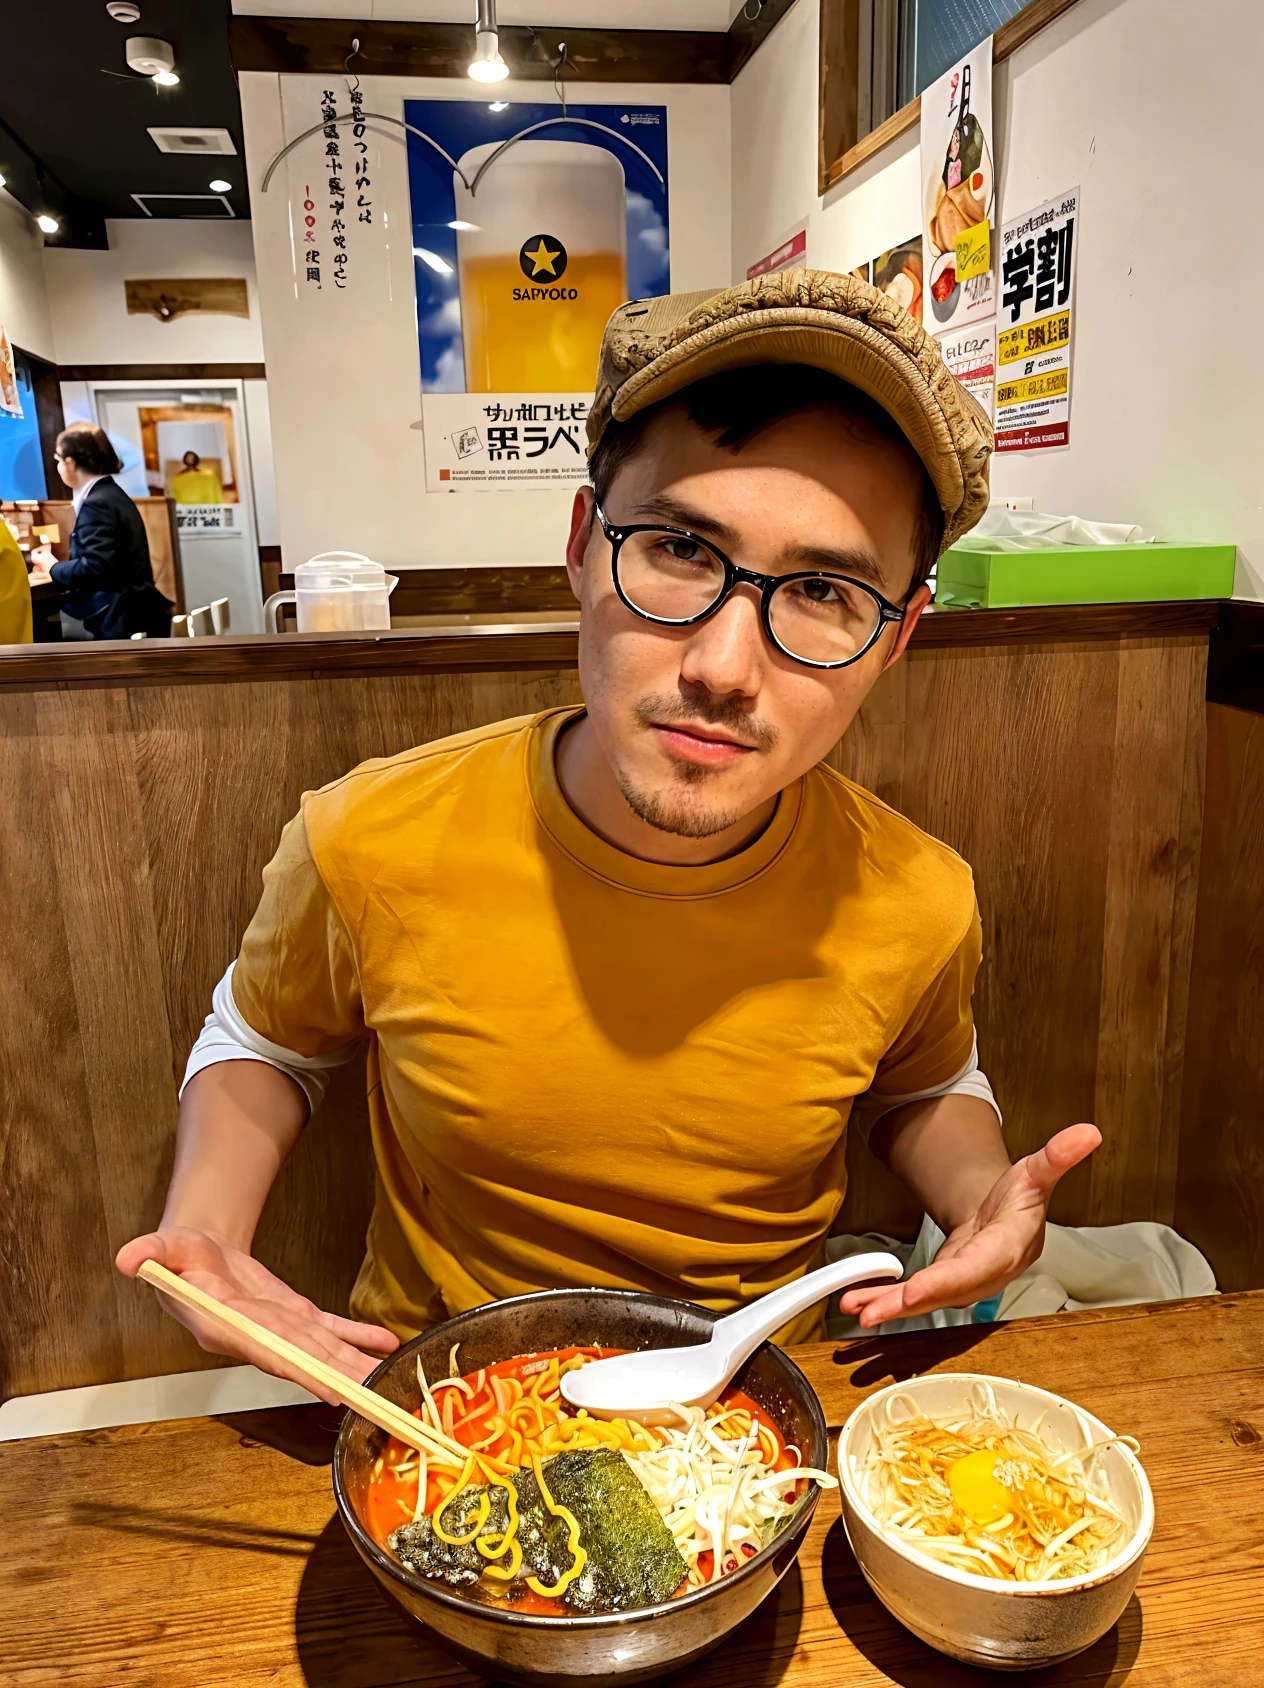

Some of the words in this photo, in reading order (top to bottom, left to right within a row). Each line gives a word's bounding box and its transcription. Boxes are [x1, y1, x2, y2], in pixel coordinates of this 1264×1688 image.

[1003, 217, 1075, 323] 学割
[487, 426, 589, 461] 黒ラベ
